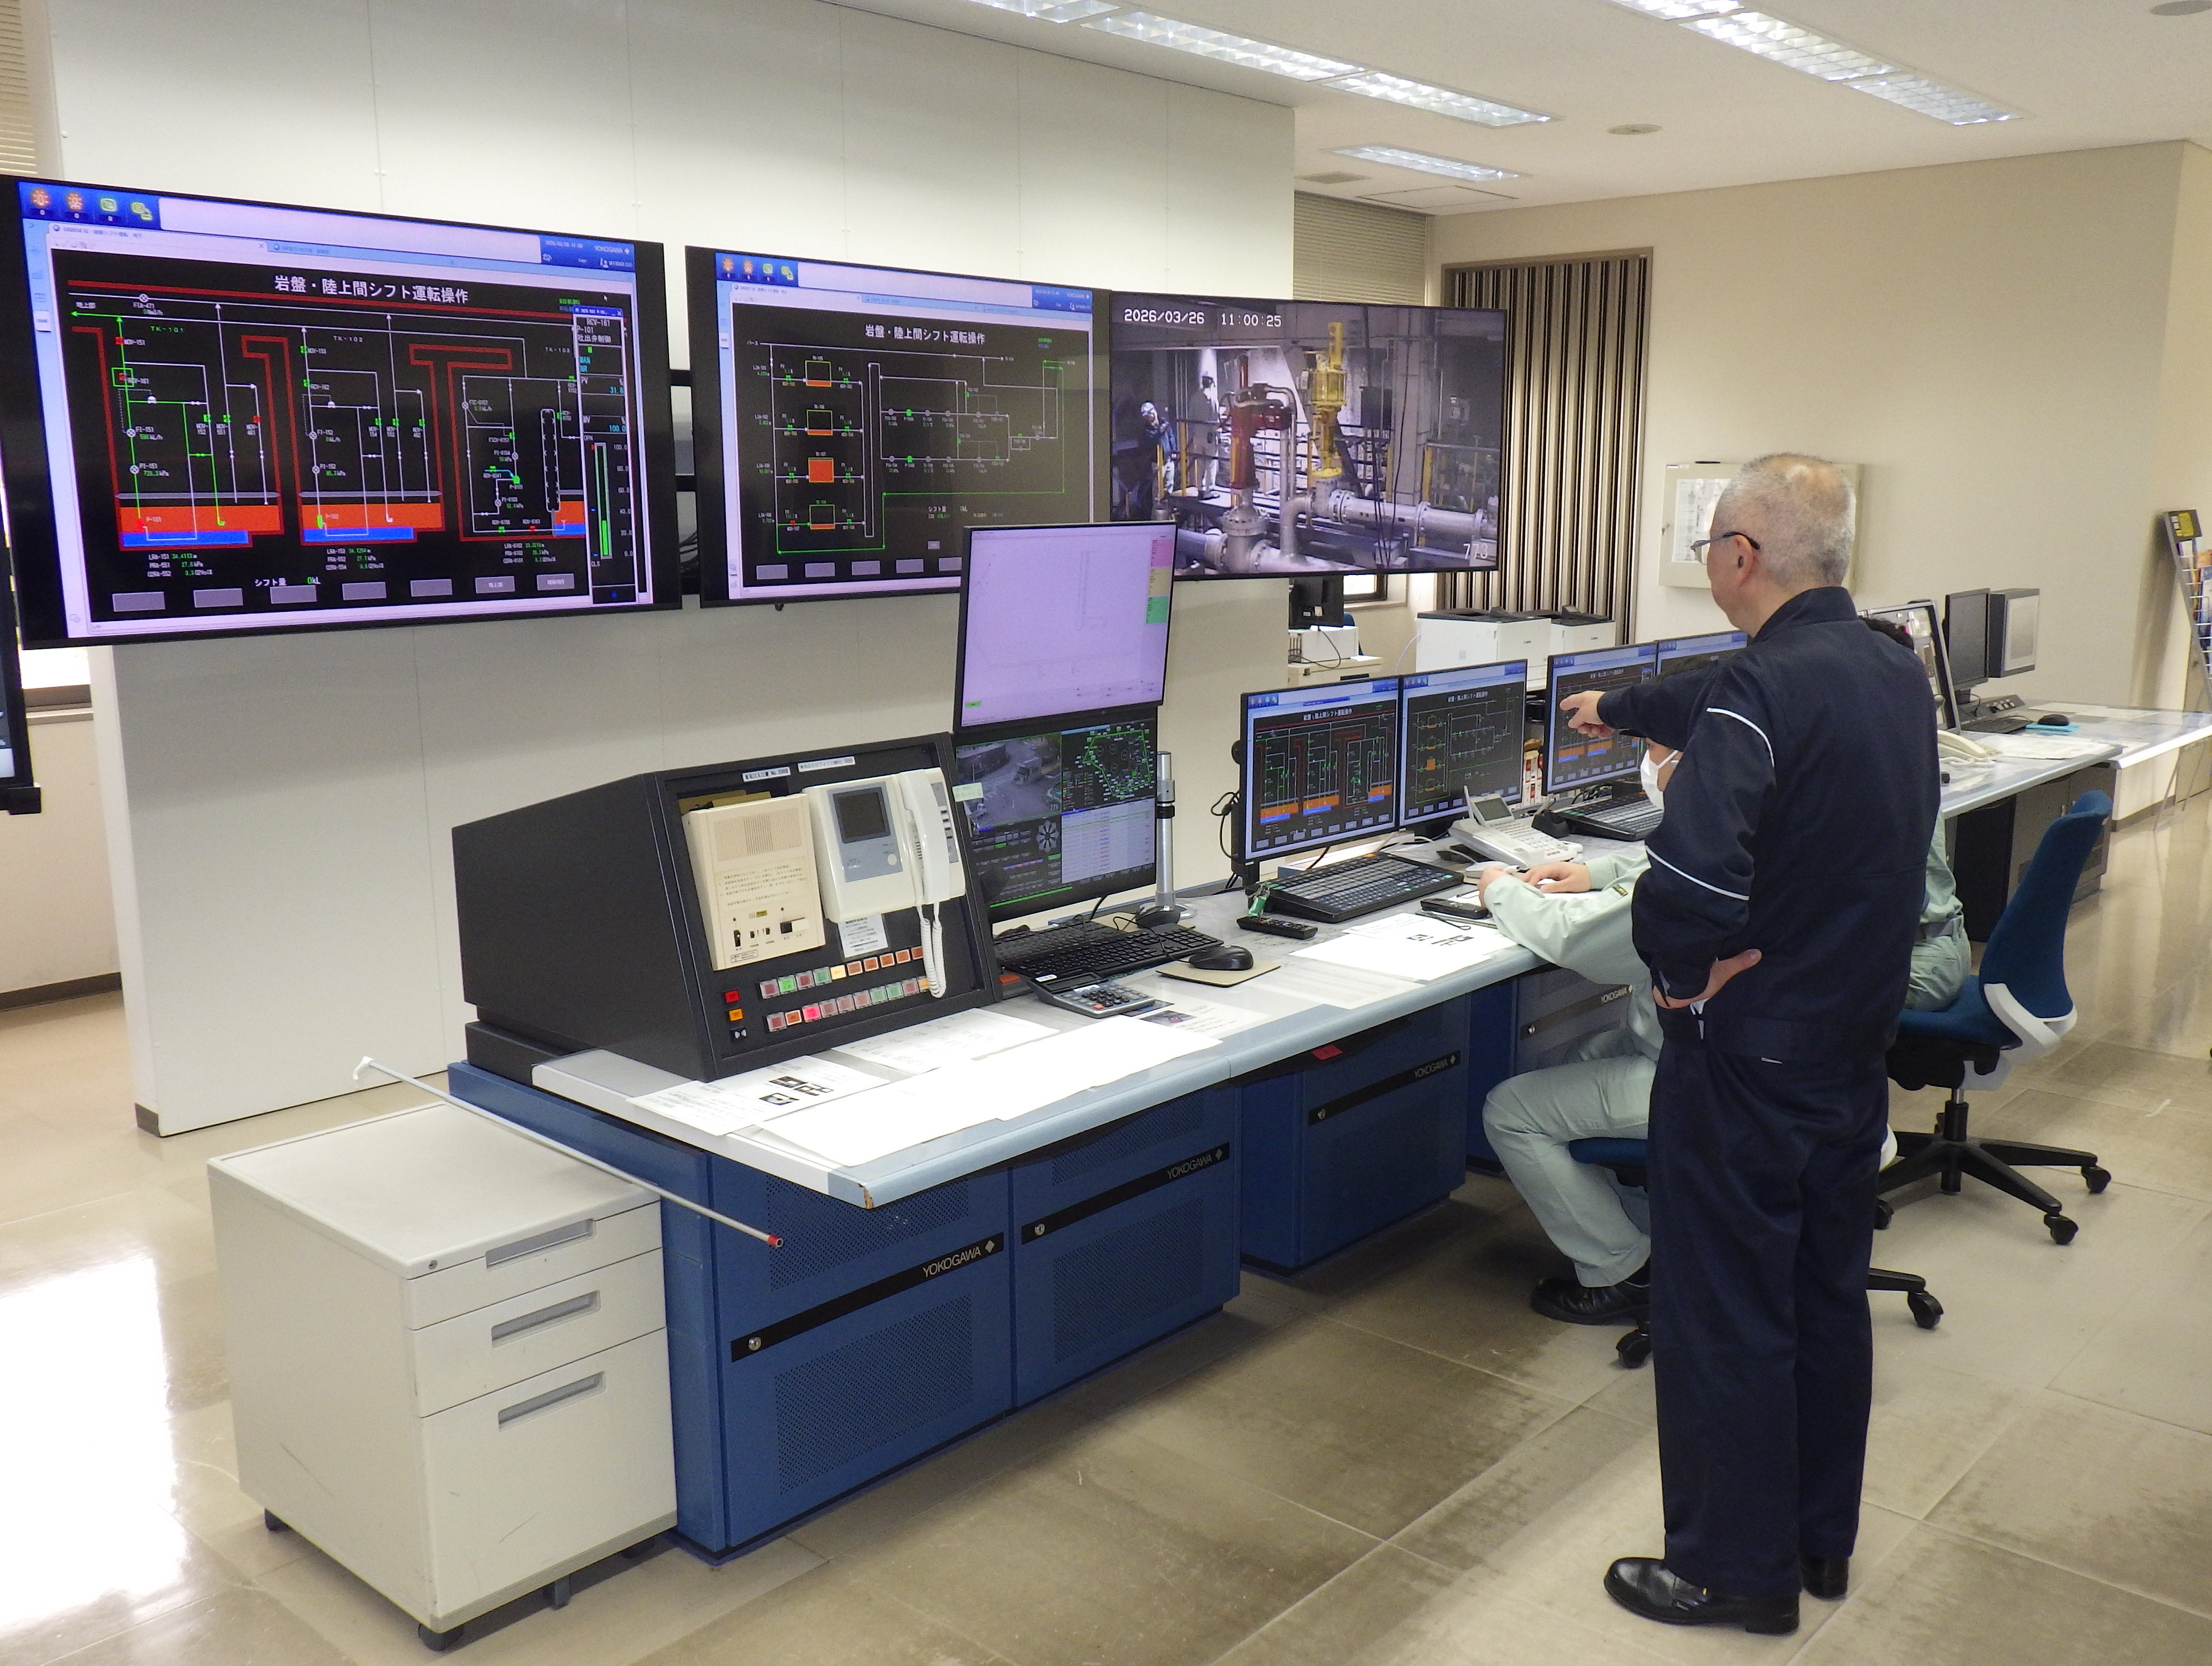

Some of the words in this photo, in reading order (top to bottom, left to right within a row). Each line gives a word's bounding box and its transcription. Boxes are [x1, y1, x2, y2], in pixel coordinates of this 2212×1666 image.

[275, 275, 468, 304] 岩盤・陸上間シフト運転操作
[586, 318, 610, 327] RCV-161
[1124, 309, 1205, 324] 2026/03/26
[1221, 313, 1282, 327] 11:00:25
[577, 325, 594, 334] P-101
[865, 324, 985, 345] 岩盤・陸上間シフト運転操作
[1463, 543, 1488, 559] 773
[254, 578, 287, 586] シフト量
[1414, 1059, 1448, 1078] YOKOGAWA
[1167, 1154, 1212, 1179] YOKOGAWA
[923, 1246, 981, 1277] YOKOGAWA
